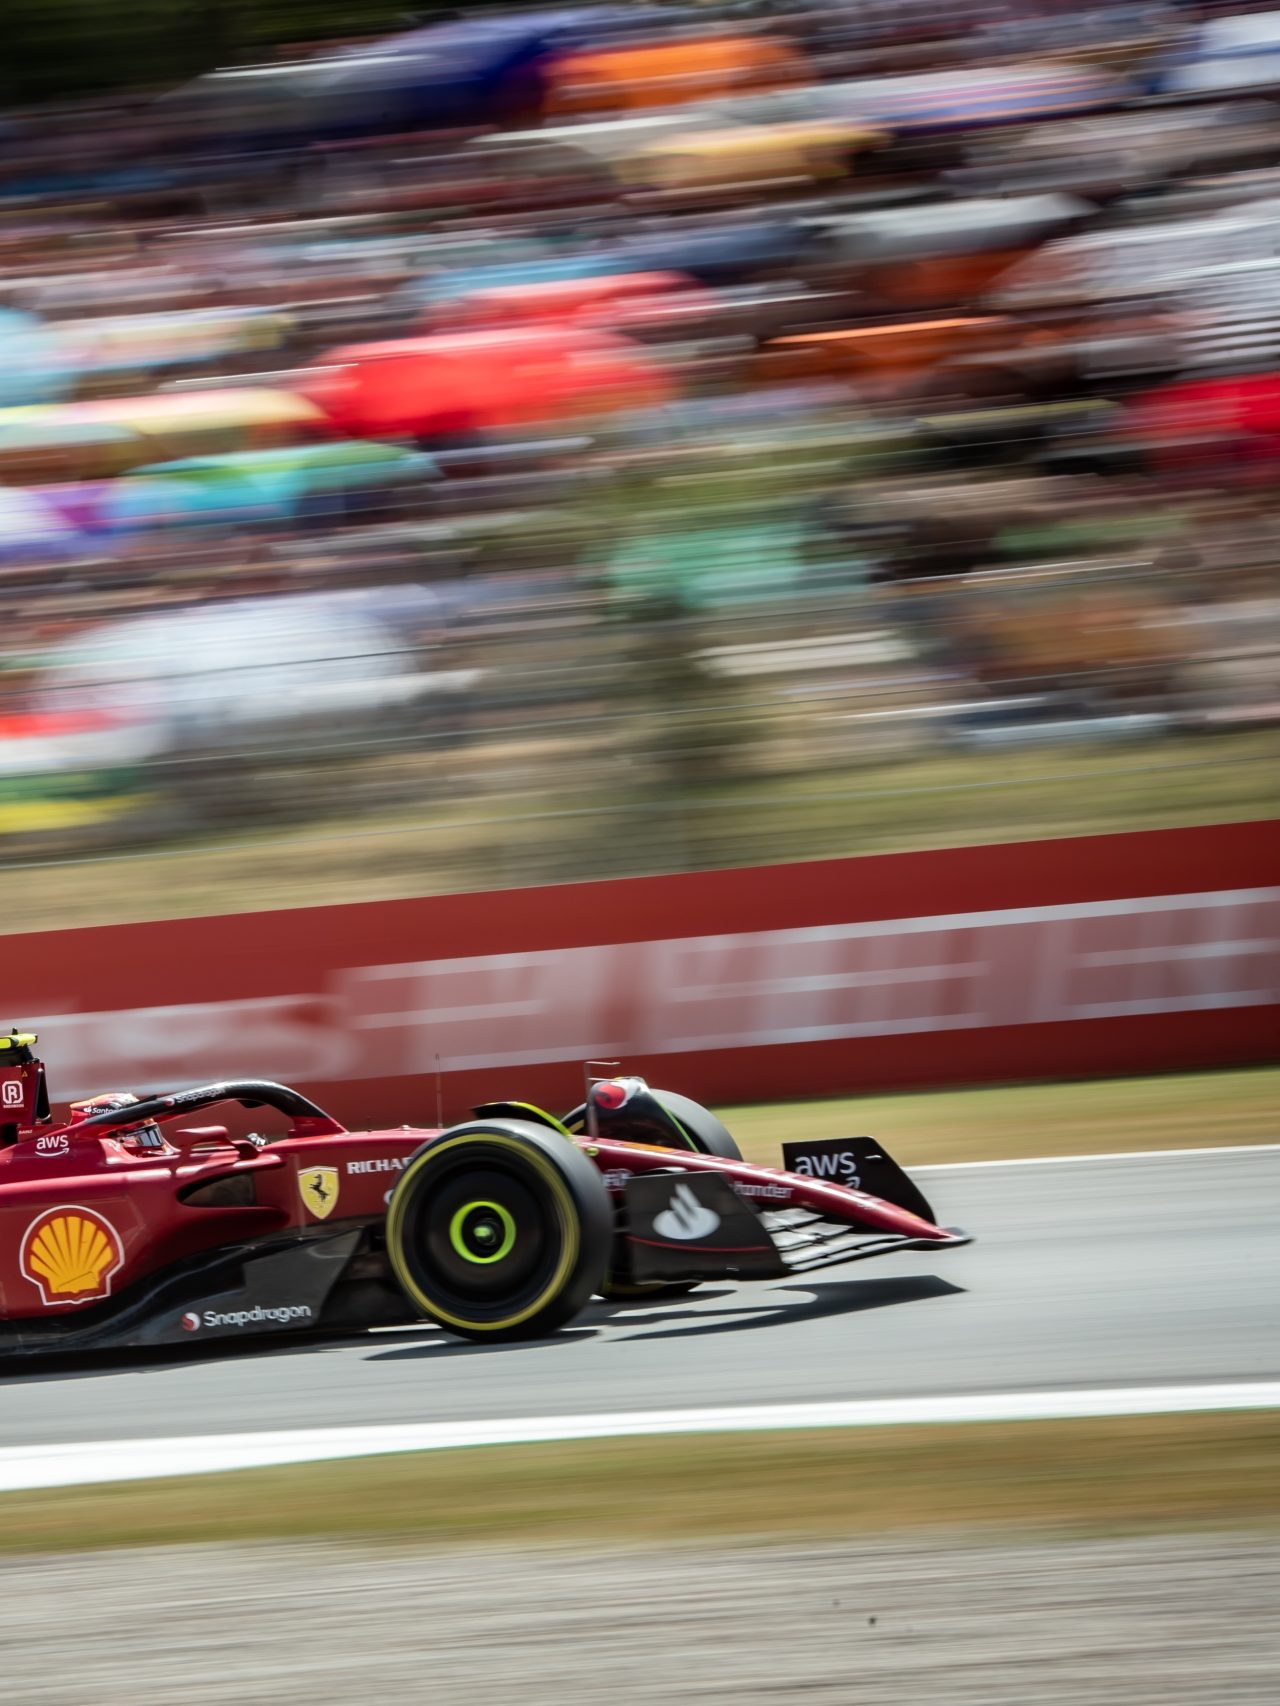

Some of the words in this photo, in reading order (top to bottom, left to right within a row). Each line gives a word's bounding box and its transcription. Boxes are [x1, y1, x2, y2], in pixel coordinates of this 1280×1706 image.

[36, 1135, 69, 1150] aws
[794, 1151, 857, 1177] aws
[202, 1305, 312, 1327] Snapdragon
